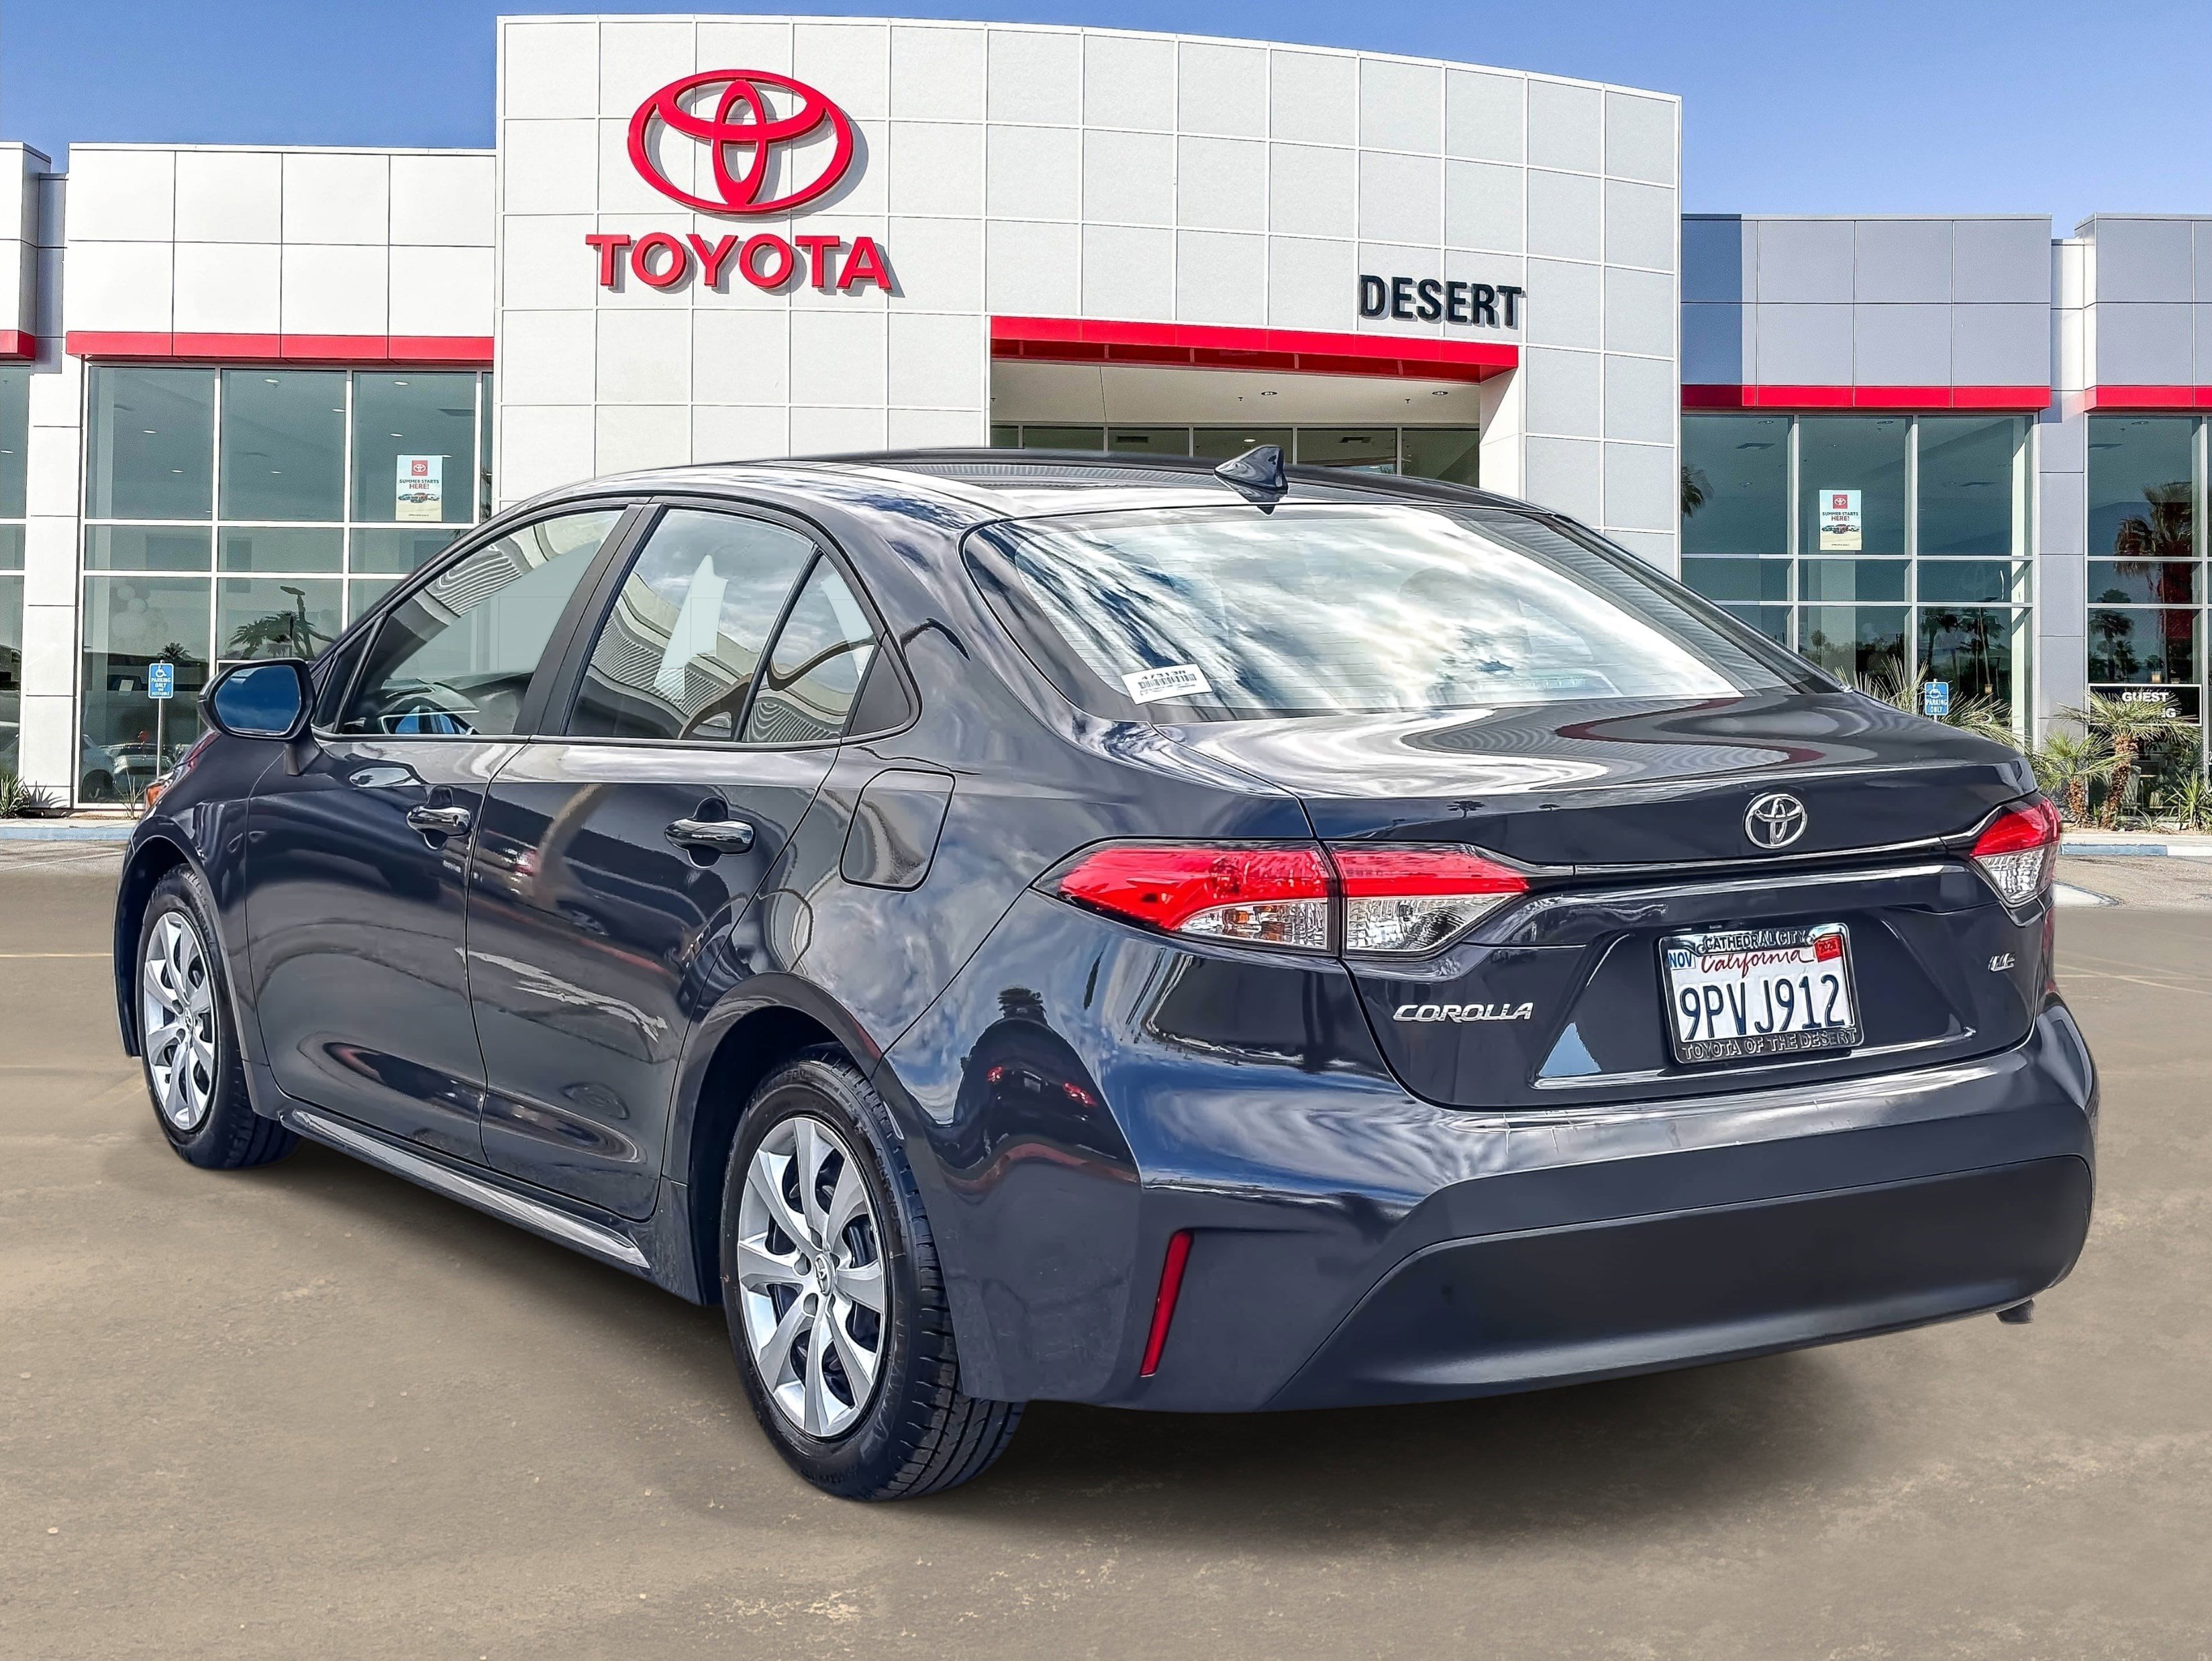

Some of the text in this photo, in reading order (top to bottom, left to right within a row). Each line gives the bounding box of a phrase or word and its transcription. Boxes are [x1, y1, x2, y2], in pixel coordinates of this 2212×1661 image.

[585, 232, 893, 291] TOYOTA
[1359, 274, 1523, 328] DESERT
[2121, 691, 2169, 702] GUEST
[1704, 929, 1807, 952] CATHEDRAL CITY
[1668, 951, 1693, 968] NOV
[1701, 948, 1814, 978] California
[1393, 1002, 1534, 1023] COROLLA
[1680, 974, 1845, 1040] 9PVJ912
[1682, 1028, 1857, 1060] TOYOTA OF THE DESERT
